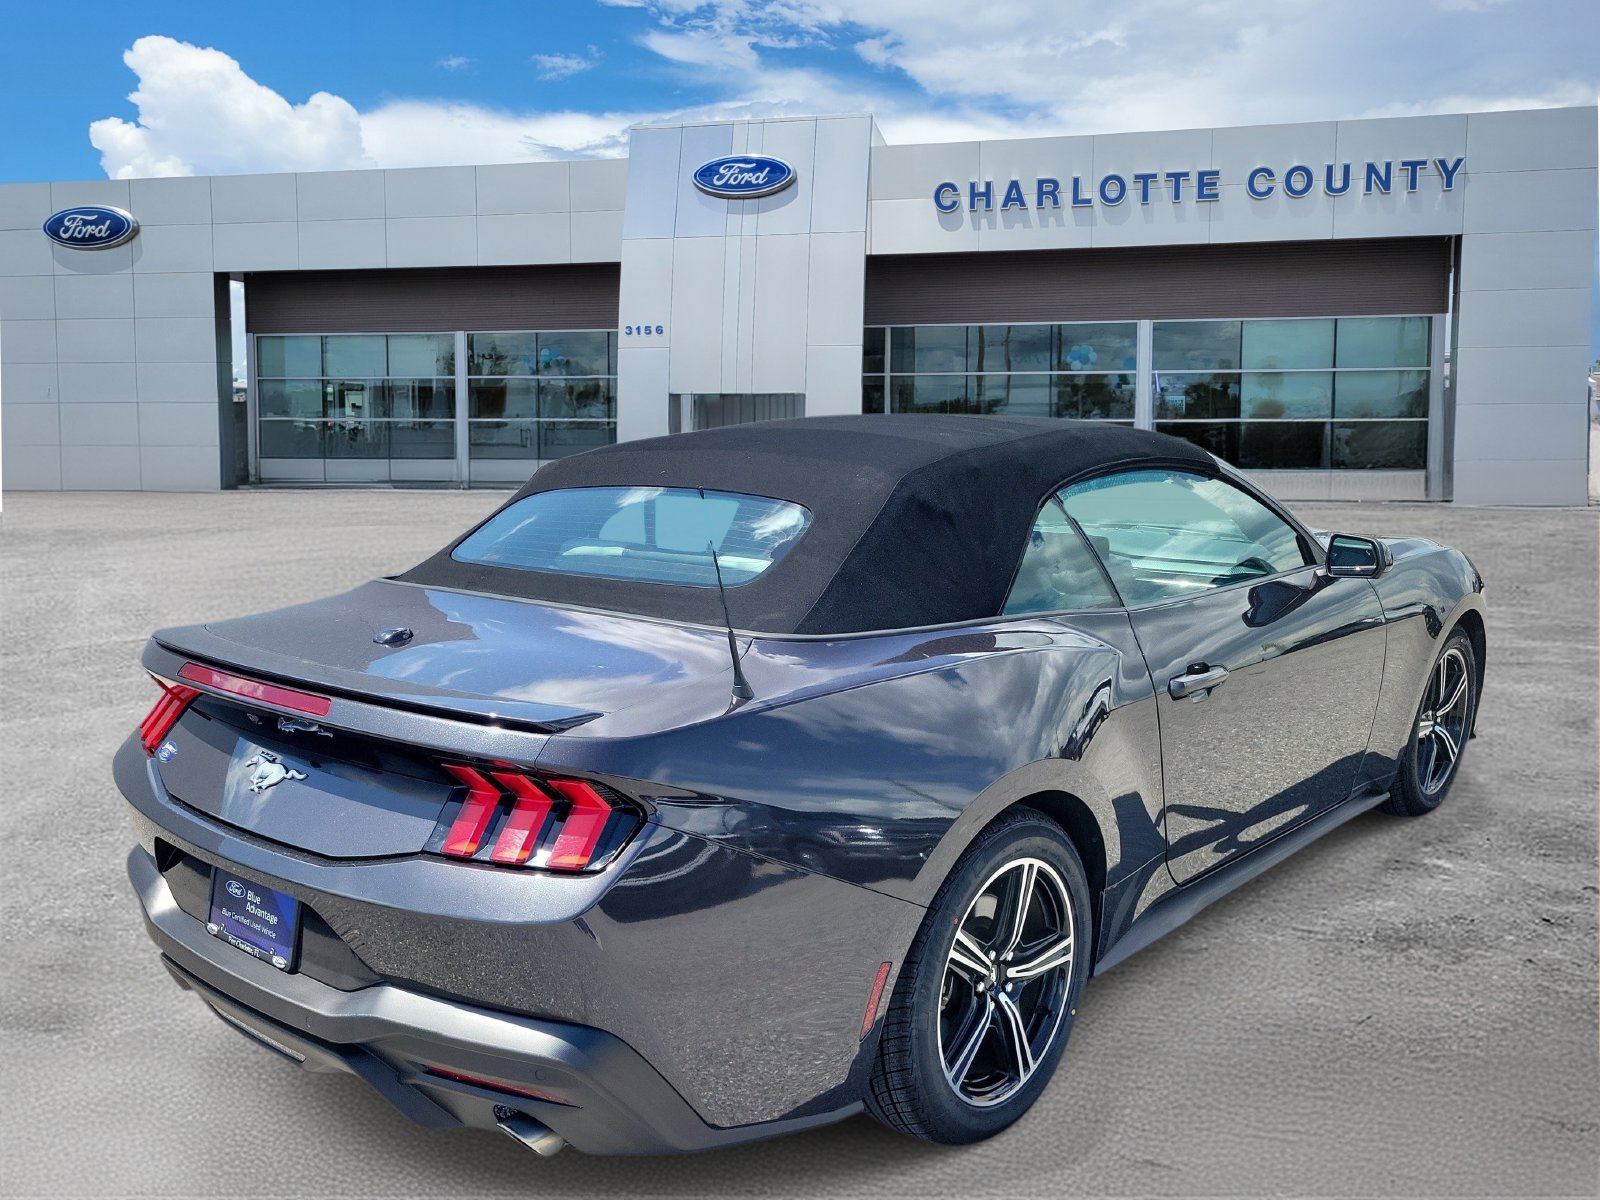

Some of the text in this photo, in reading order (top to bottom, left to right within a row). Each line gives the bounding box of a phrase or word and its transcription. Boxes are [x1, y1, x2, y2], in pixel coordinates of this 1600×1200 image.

[713, 163, 770, 186] Ford
[933, 156, 1465, 213] CHARLOTTE COUNTY
[59, 214, 111, 239] Ford
[625, 325, 664, 336] 3156
[247, 890, 261, 904] Blue
[246, 902, 278, 925] Advantage
